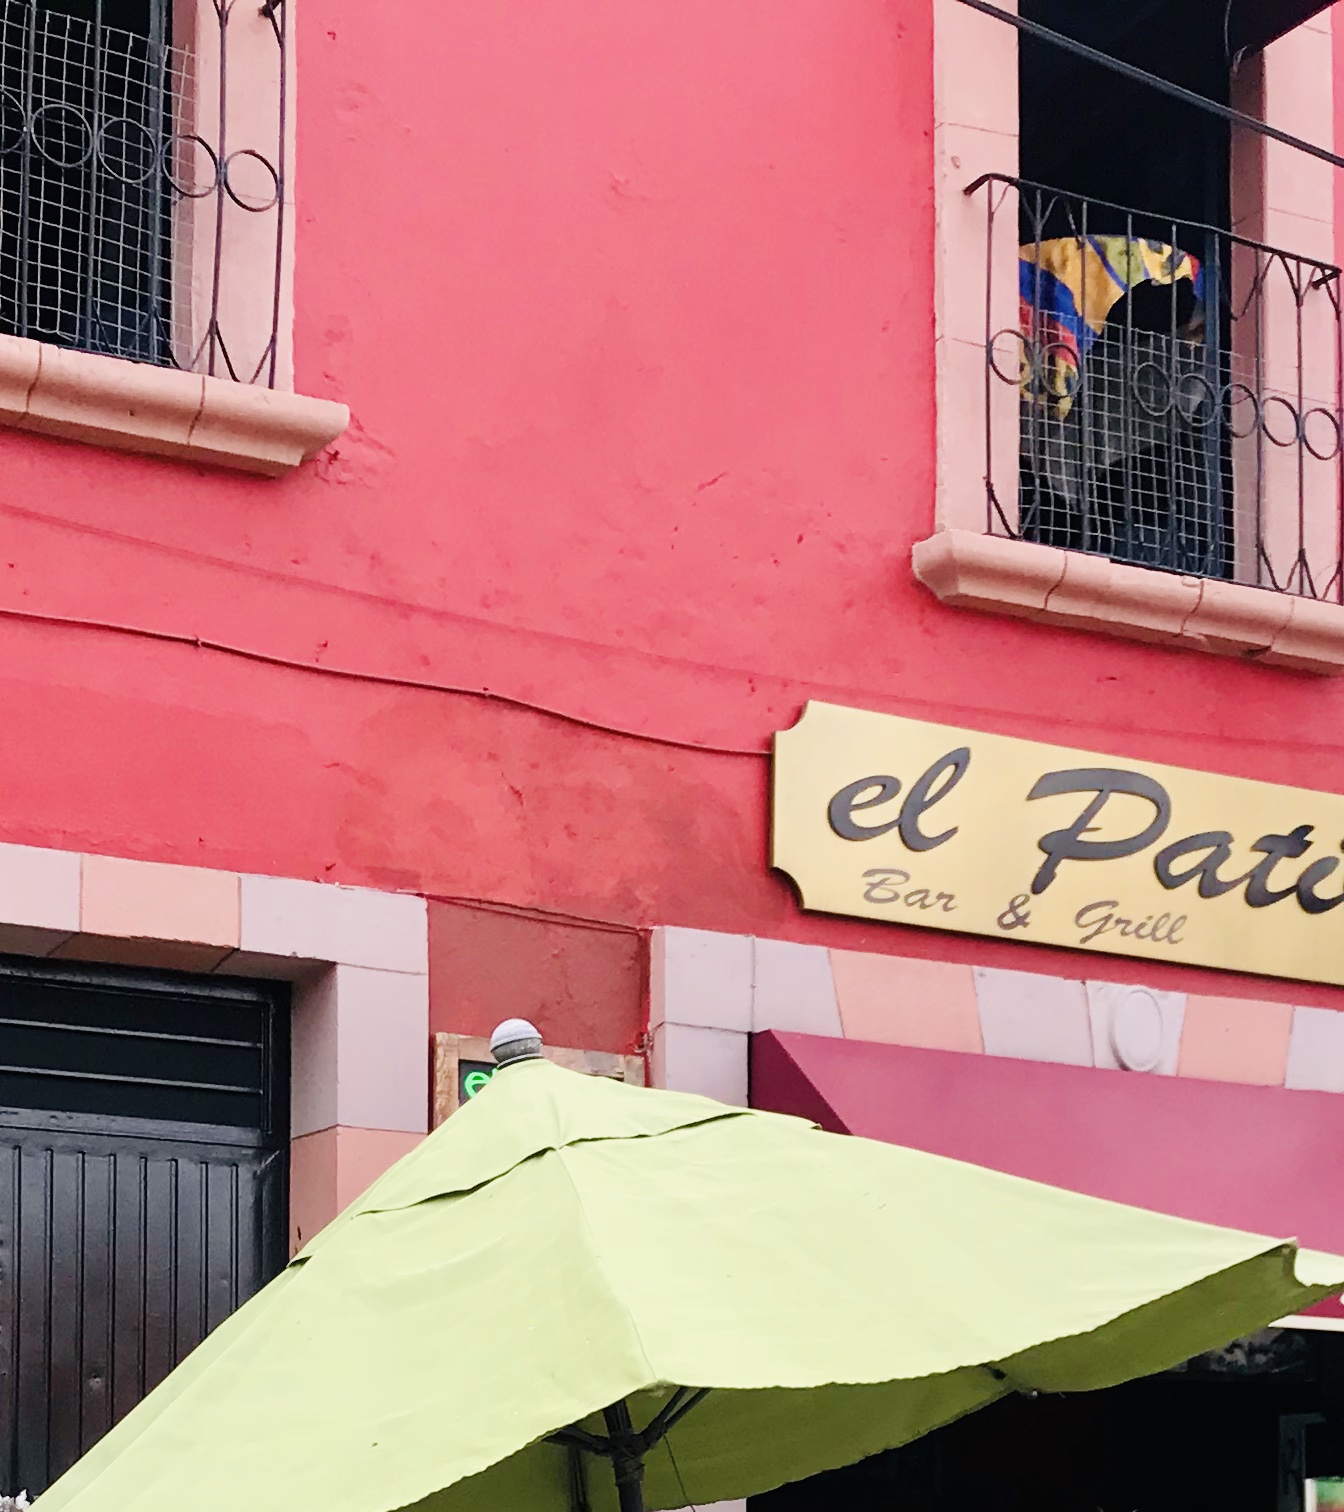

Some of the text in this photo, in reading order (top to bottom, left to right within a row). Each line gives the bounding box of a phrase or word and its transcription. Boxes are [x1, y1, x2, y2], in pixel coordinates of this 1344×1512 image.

[827, 746, 972, 852] el
[860, 868, 1187, 945] Bar & Grill
